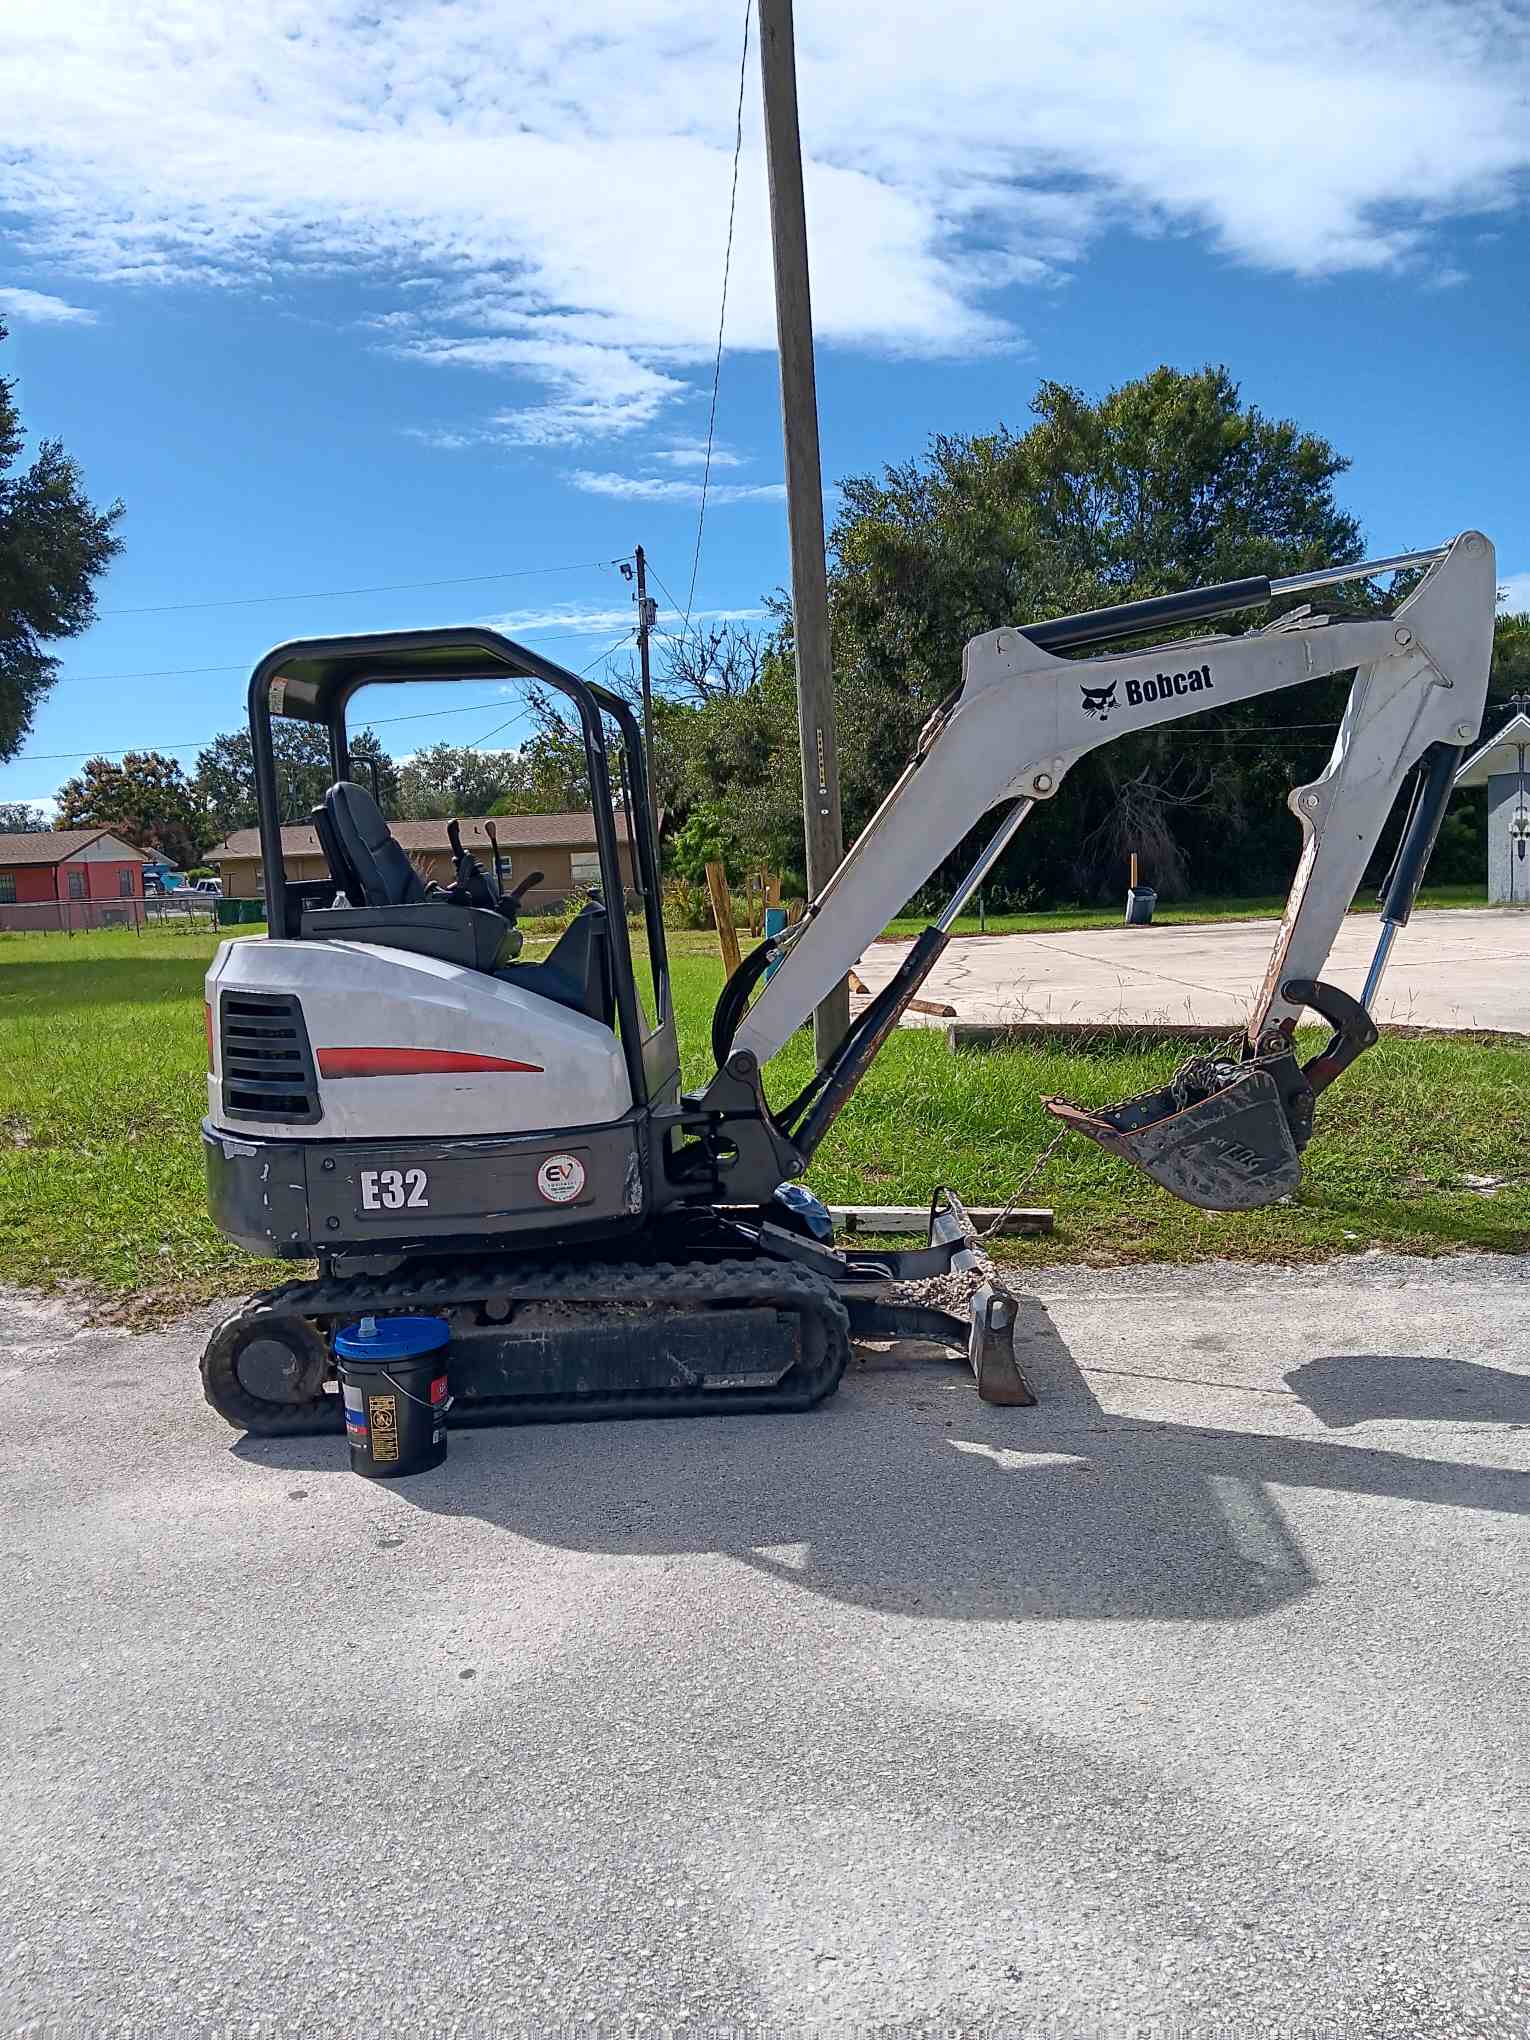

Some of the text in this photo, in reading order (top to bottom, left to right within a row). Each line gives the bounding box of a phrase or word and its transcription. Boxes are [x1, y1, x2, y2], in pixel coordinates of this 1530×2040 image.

[1125, 665, 1214, 706] Bobcat
[360, 1168, 429, 1210] E32
[545, 1163, 573, 1181] EV
